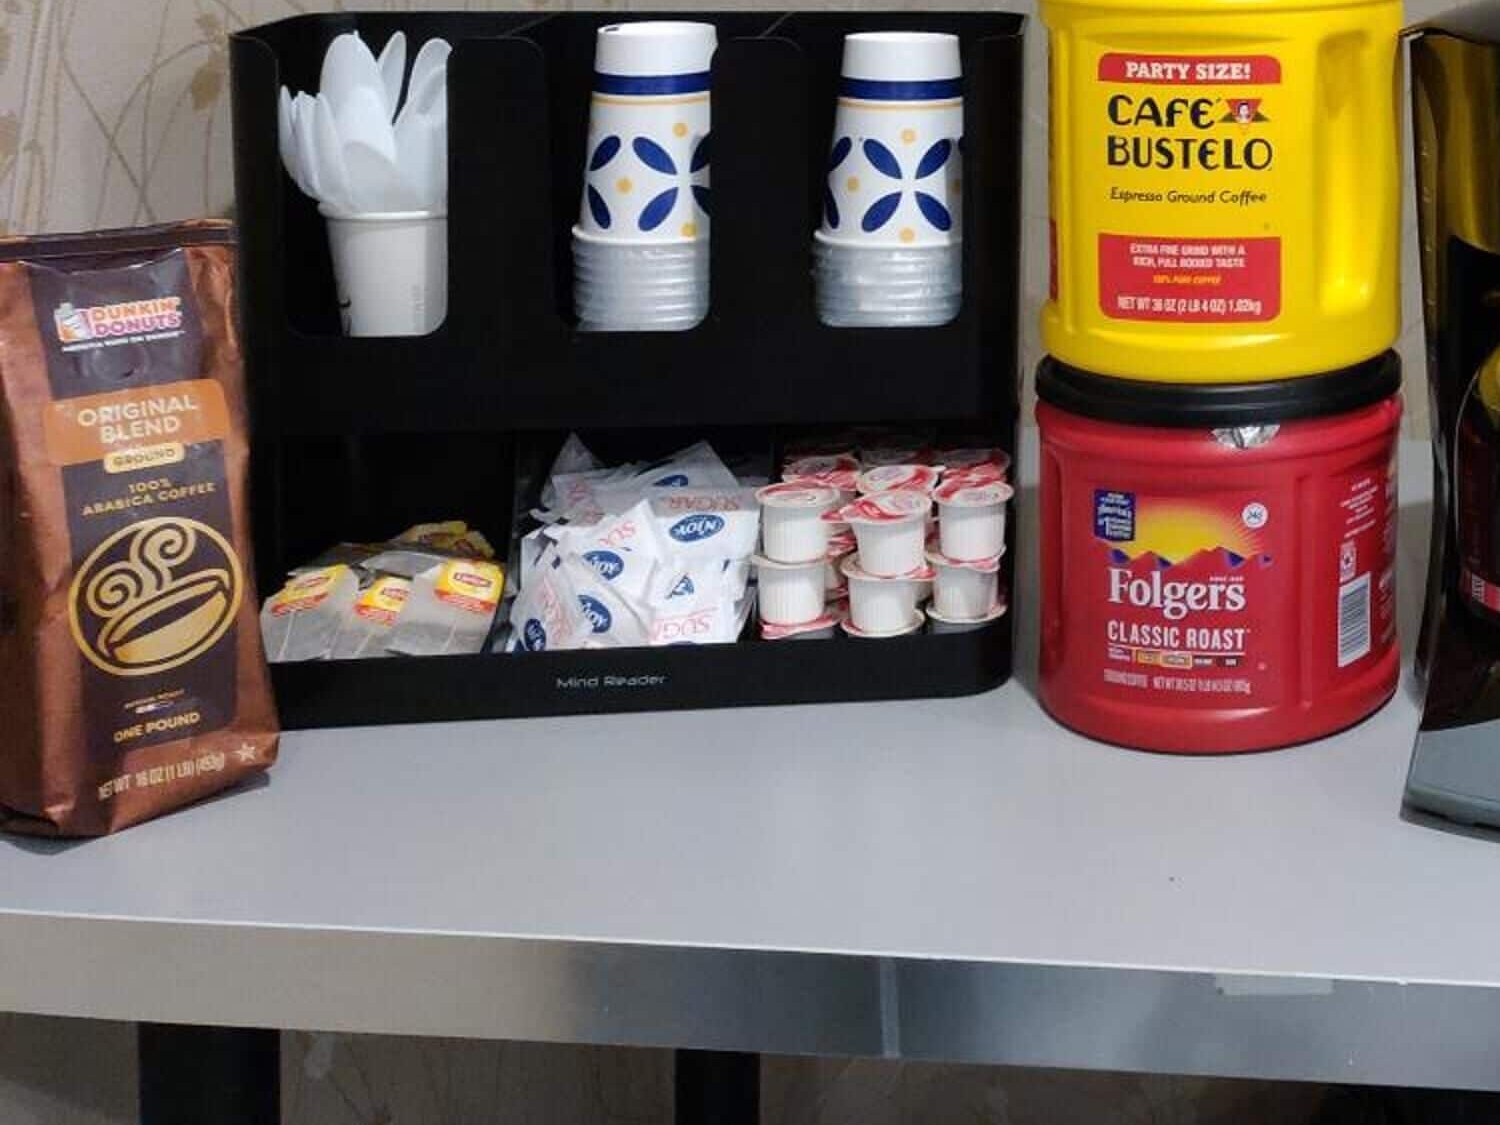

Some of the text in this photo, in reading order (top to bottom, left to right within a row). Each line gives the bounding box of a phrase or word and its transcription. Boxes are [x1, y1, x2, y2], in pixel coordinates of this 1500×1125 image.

[1126, 62, 1251, 80] PARTY SIZE!
[1108, 136, 1273, 170] BUSTELO
[1110, 187, 1267, 207] Espresso Ground Coffee
[1117, 295, 1136, 310] NET
[94, 313, 179, 336] DONUTS
[78, 394, 199, 426] ORIGINAL
[101, 415, 181, 444] BLEND
[112, 447, 176, 467] GROUND
[81, 482, 217, 516] ARABICA COFFEE
[1108, 567, 1246, 620] Folgers
[1107, 620, 1246, 650] CLASSIC ROAST
[557, 675, 665, 688] Mind Reader
[113, 712, 200, 743] ONE POUND
